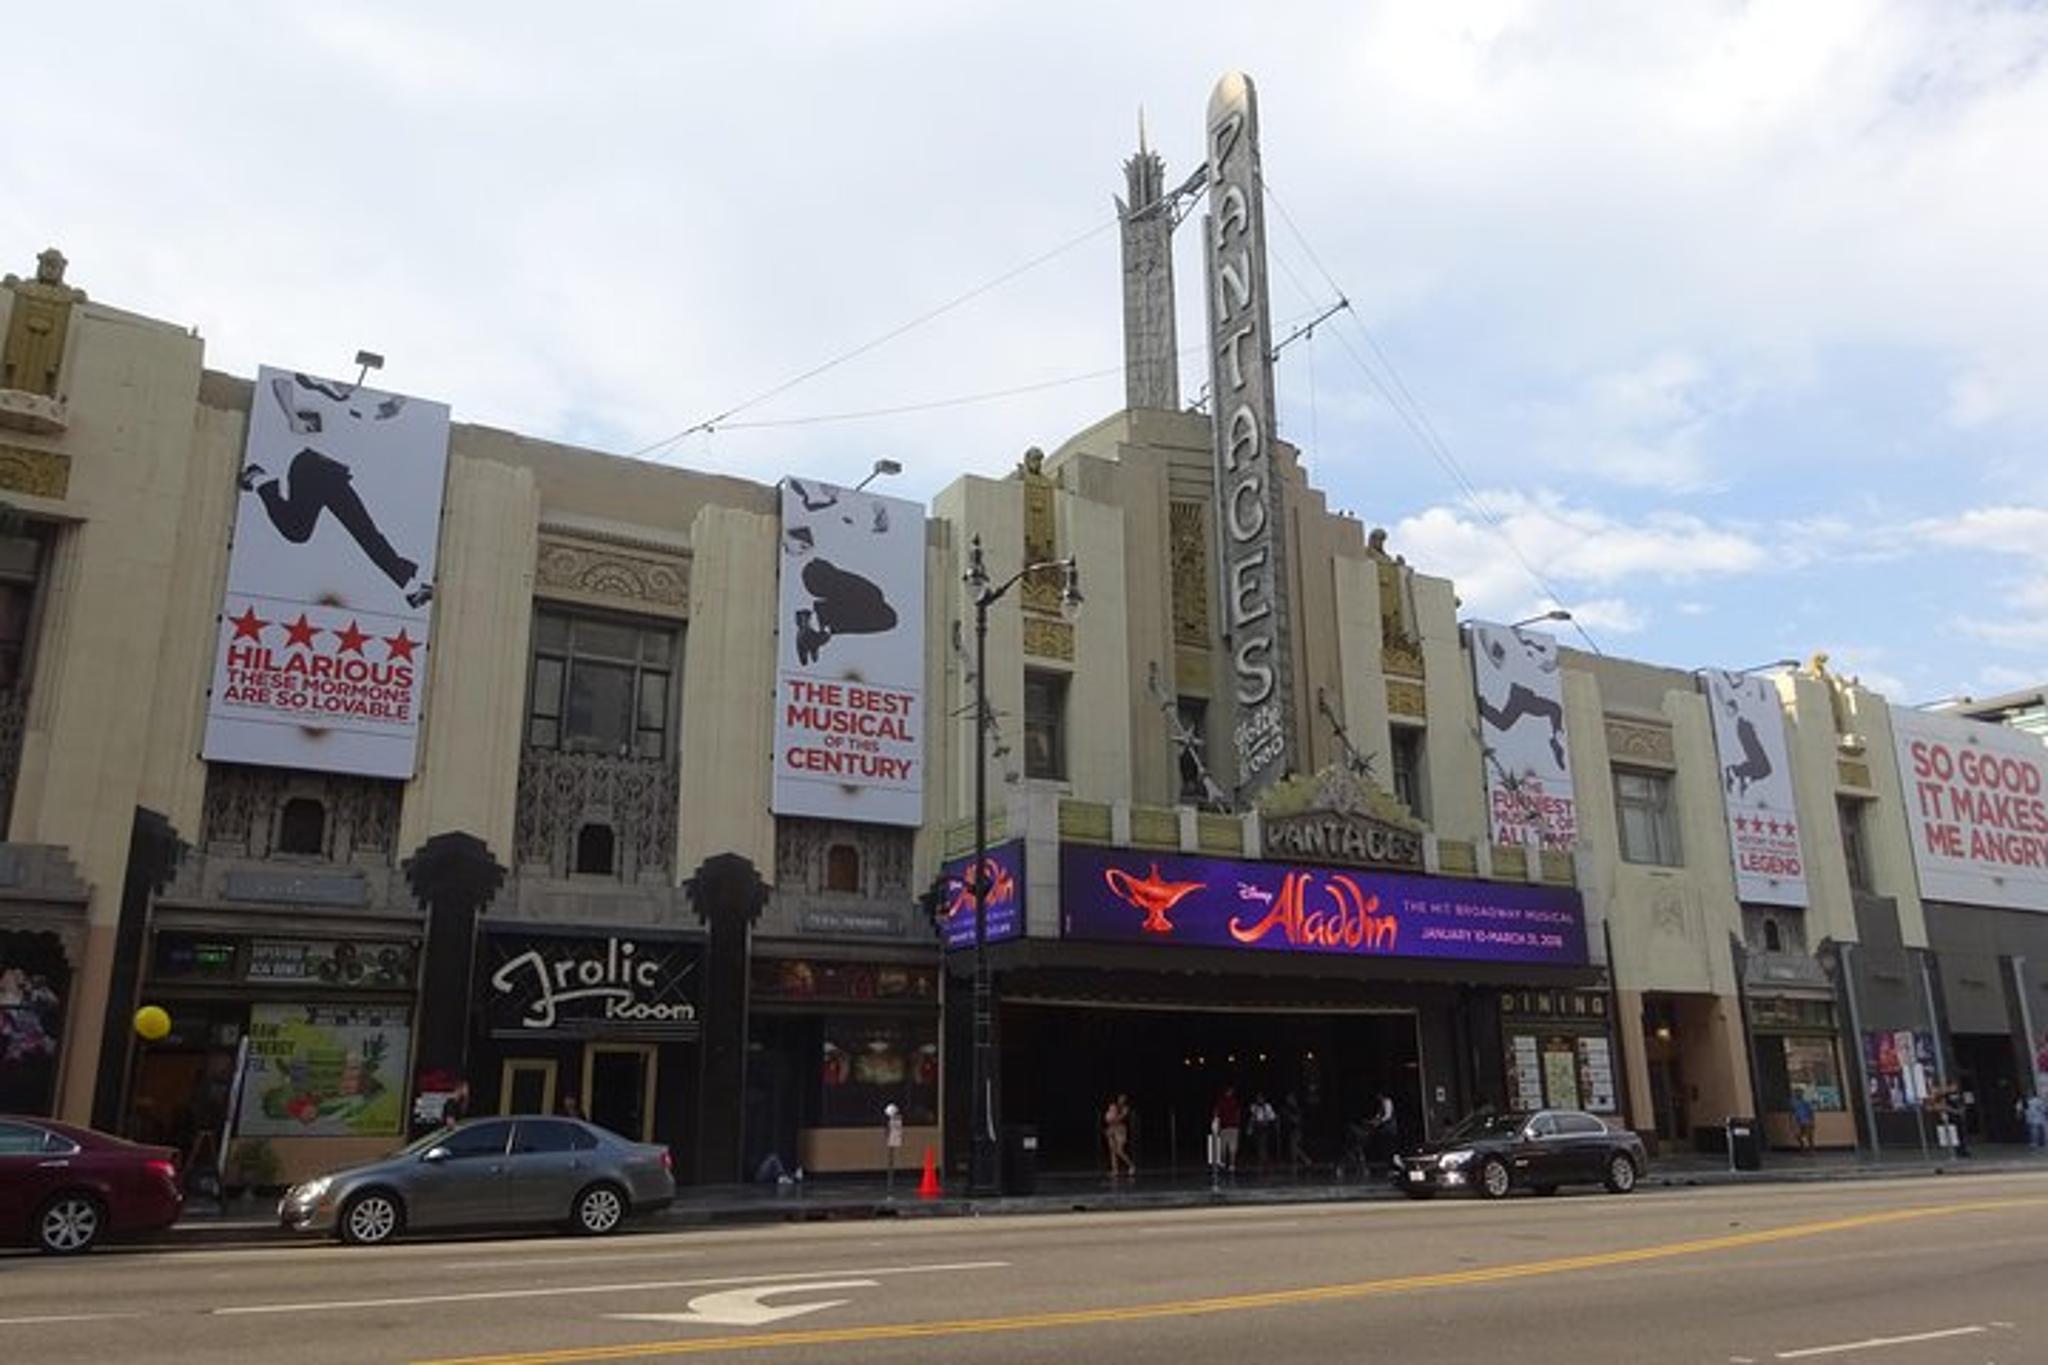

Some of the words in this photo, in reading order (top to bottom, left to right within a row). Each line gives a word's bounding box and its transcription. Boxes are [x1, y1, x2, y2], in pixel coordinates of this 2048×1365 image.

[1210, 113, 1276, 707] PANTAGES
[227, 645, 413, 688] HILARIOUS
[224, 685, 269, 703] ARE
[275, 690, 307, 707] SO
[312, 696, 409, 719] LOVABLE
[227, 669, 297, 689] THESE
[302, 679, 411, 703] MORMONS
[788, 680, 842, 706] THE
[847, 687, 914, 716] BEST
[787, 704, 914, 742] MUSICAL
[824, 735, 843, 747] OF
[847, 738, 880, 752] THIS
[786, 747, 912, 780] CENTURY
[1911, 741, 1954, 781] SO
[1959, 750, 2041, 796] GOOD
[1917, 782, 1943, 818] IT
[1950, 786, 2048, 834] MAKES
[1266, 820, 1420, 863] PANTAGES
[1925, 821, 1965, 858] ME
[1740, 853, 1801, 877] LEGEND
[1229, 872, 1398, 950] Aladdin
[1404, 900, 1426, 913] THE
[1455, 903, 1522, 919] BROADWAY
[1421, 927, 1472, 942] JANUARY
[491, 937, 659, 1029] Frolic
[605, 993, 696, 1019] Room
[1501, 992, 1604, 1015] DINING
